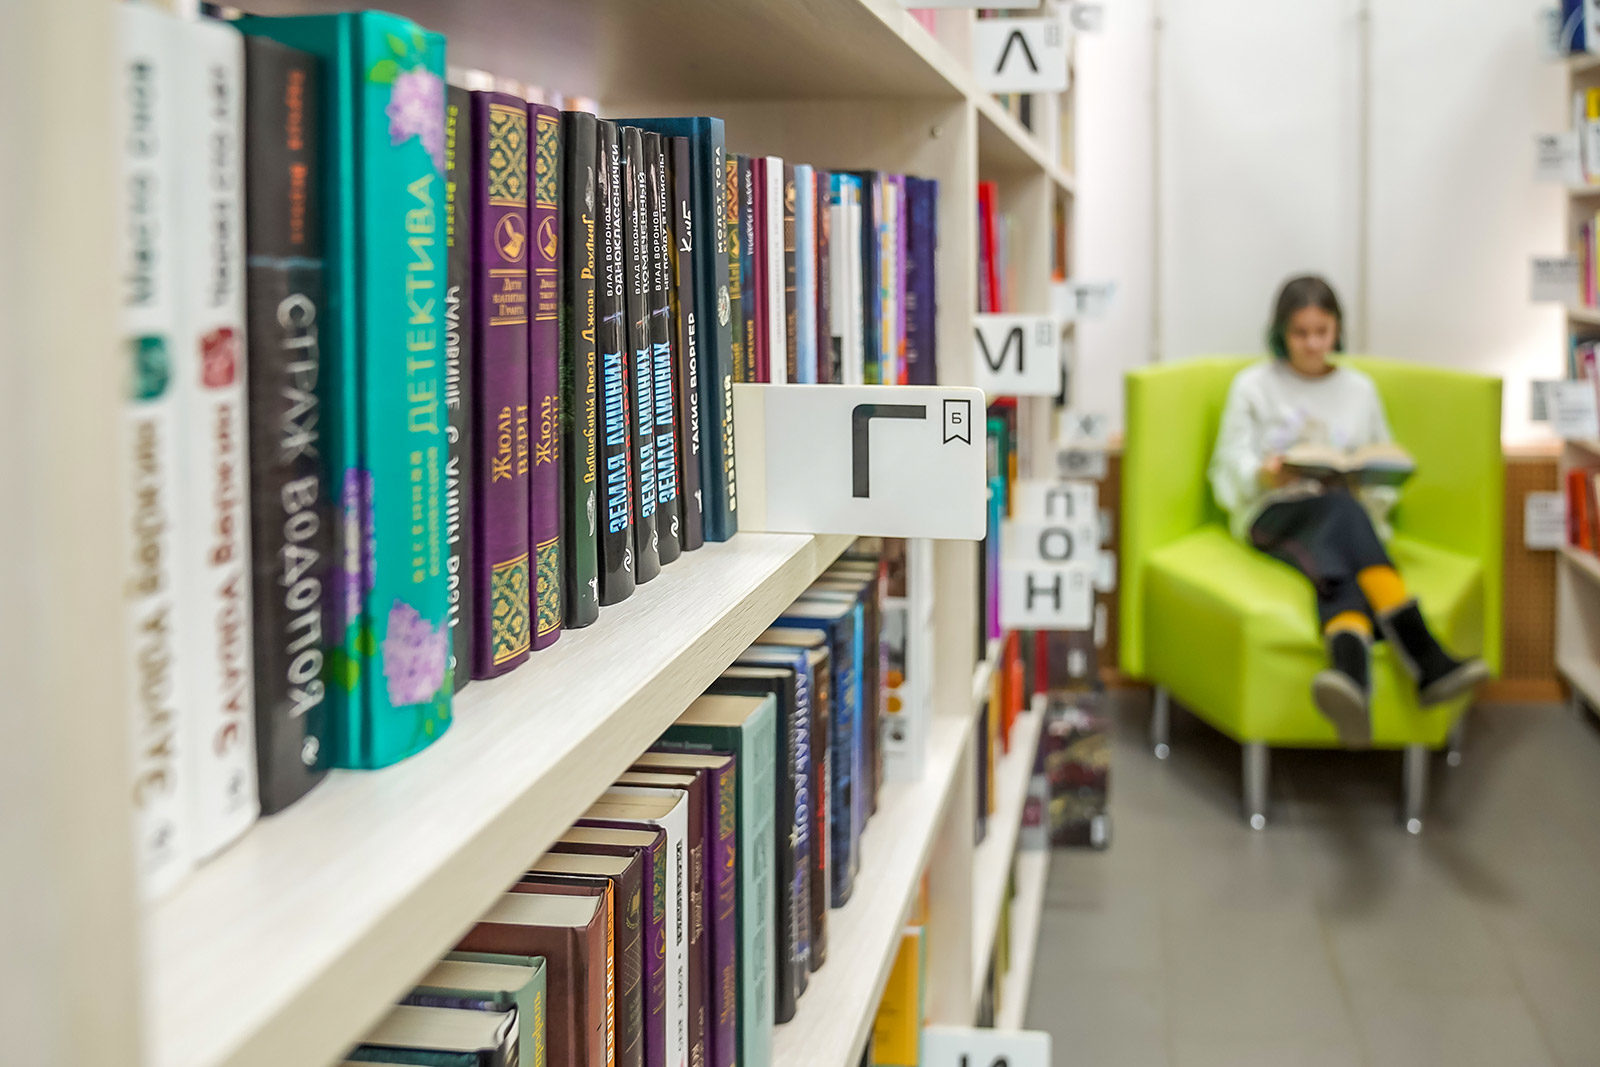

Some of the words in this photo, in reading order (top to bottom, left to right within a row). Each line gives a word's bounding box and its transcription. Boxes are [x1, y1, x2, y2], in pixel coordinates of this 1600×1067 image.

[995, 29, 1038, 74] Л
[580, 213, 596, 280] Роулинг
[611, 143, 624, 296] ОДНОКЛАССНИЧКИ
[638, 171, 650, 294] ПОМЕЧЕННЫЙ
[652, 210, 661, 260] ВОРОНОВ
[716, 195, 724, 254] МОЛОТ
[405, 172, 440, 435] ДЕТЕКТИВА
[606, 265, 614, 296] ВЛАД
[634, 265, 642, 295] ВЛАД
[654, 262, 663, 291] ВЛАД
[581, 289, 596, 344] Джоан
[687, 312, 698, 388] ВЮРГЕР
[276, 293, 321, 465] СТРАЖ
[603, 350, 626, 447] ЛИШНИХ
[636, 347, 655, 438] ЛИШНИХ
[653, 340, 674, 427] ЛИШНИХ
[583, 396, 597, 484] Волшебный
[690, 391, 700, 455] ТАКИС
[723, 375, 736, 511] ВЯЗЕМСКИЙ
[852, 403, 927, 499] Г
[951, 412, 962, 424] Б
[607, 452, 628, 535] ЗЕМЛЯ
[640, 442, 657, 518] ЗЕМЛЯ
[657, 431, 676, 504] ЗЕМЛЯ
[280, 475, 326, 719] ВОДОПОЯ
[1025, 573, 1062, 611] Н
